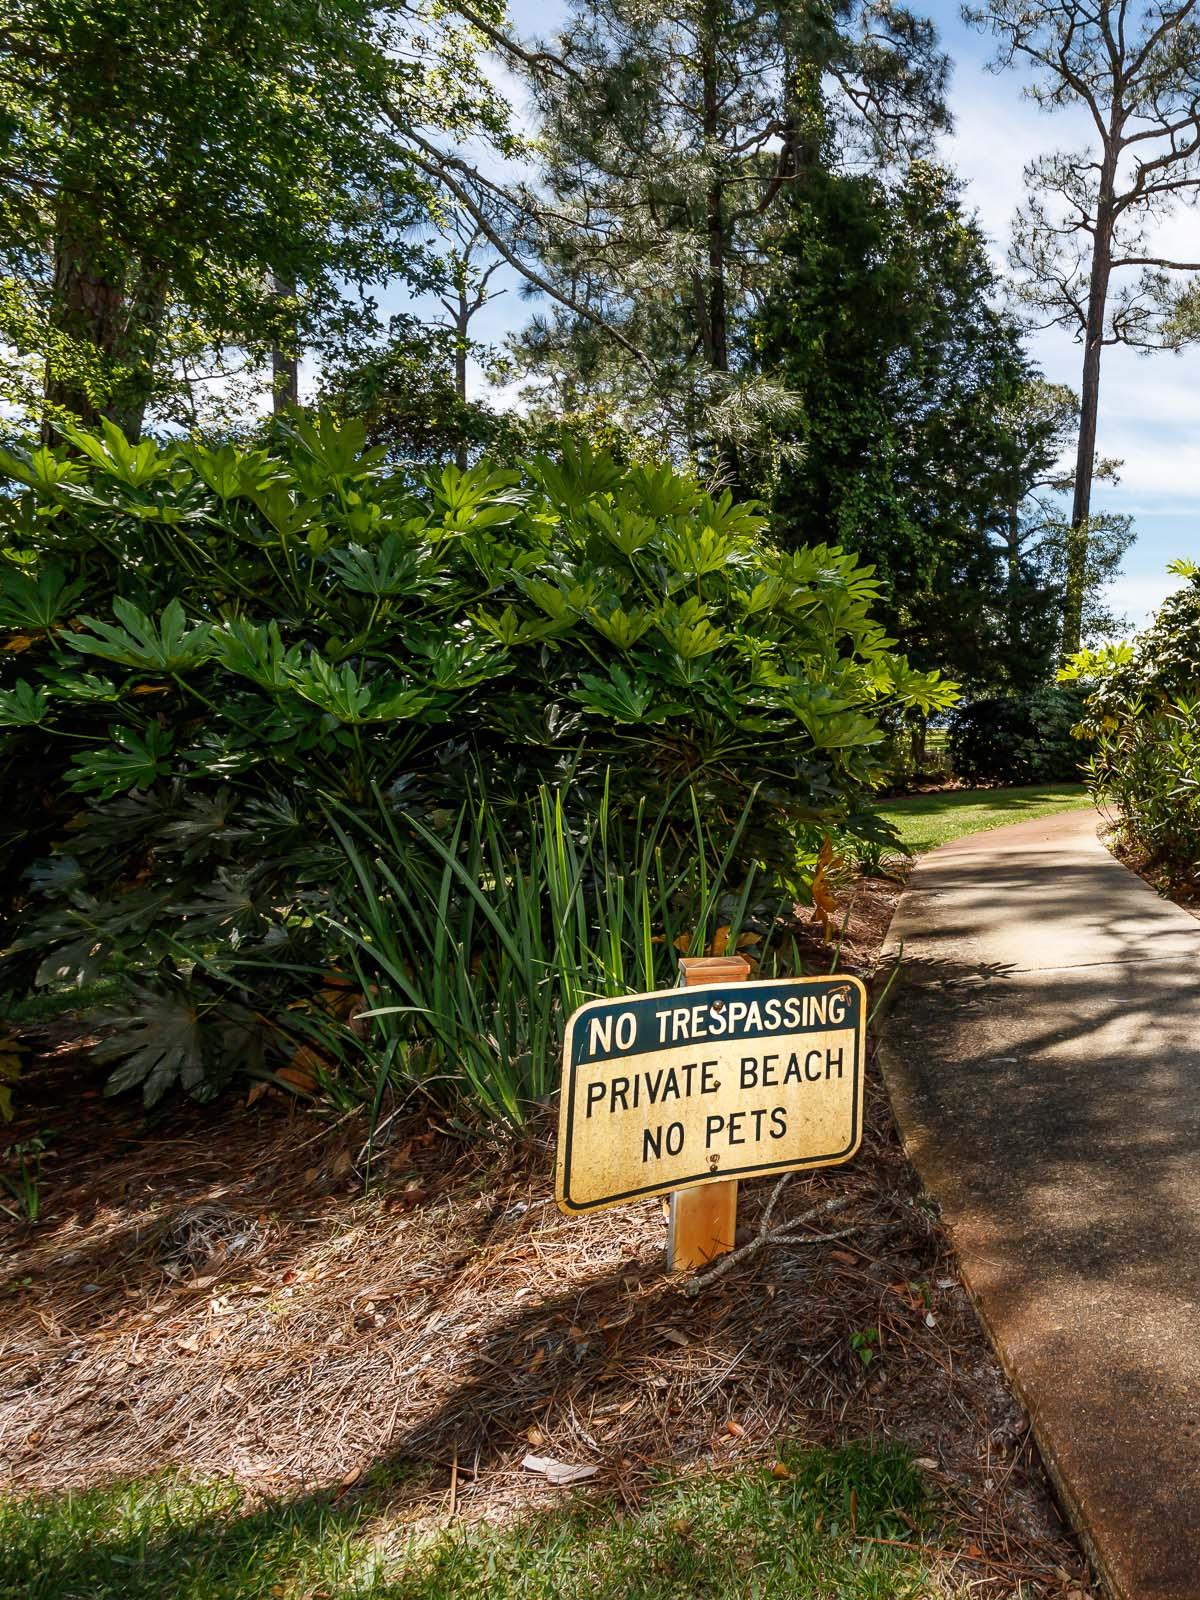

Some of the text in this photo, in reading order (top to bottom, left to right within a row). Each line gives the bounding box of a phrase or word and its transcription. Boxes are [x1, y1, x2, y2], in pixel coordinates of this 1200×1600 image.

[589, 993, 846, 1056] NO TRESPASSING
[586, 1047, 844, 1118] PRIVATE BEACH
[642, 1106, 788, 1163] NO PETS
